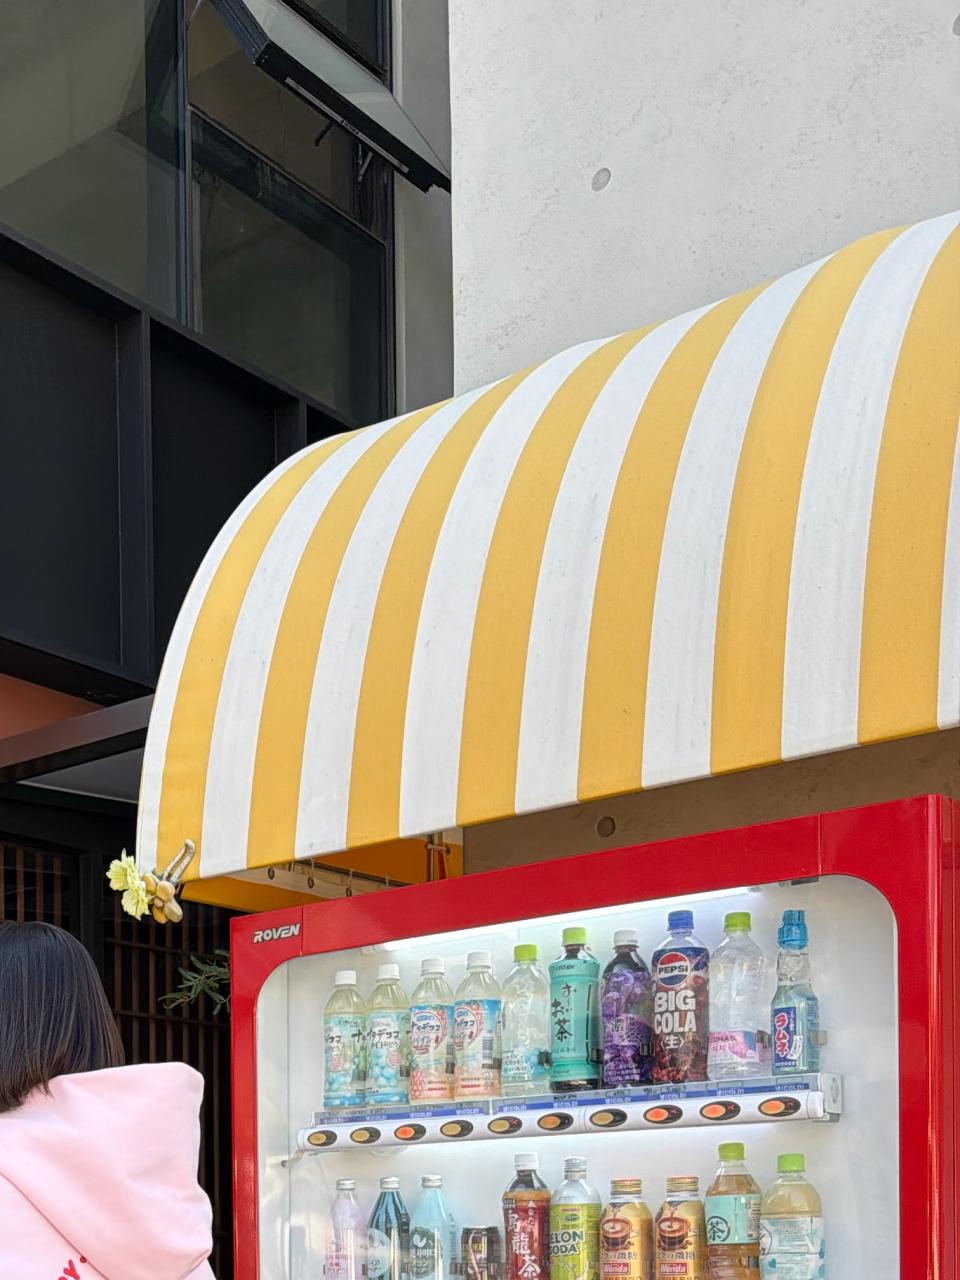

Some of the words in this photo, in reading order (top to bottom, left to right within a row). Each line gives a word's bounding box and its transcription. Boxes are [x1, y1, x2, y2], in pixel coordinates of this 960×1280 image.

[253, 923, 300, 943] ROVEN
[658, 964, 689, 974] PEPSI
[654, 989, 696, 1013] BIG
[551, 998, 573, 1042] お茶
[654, 1011, 697, 1034] COLA
[774, 1012, 790, 1058] ラムネ
[551, 1230, 584, 1244] ELON
[708, 1220, 726, 1241] 茶
[660, 1263, 687, 1273] Wonda
